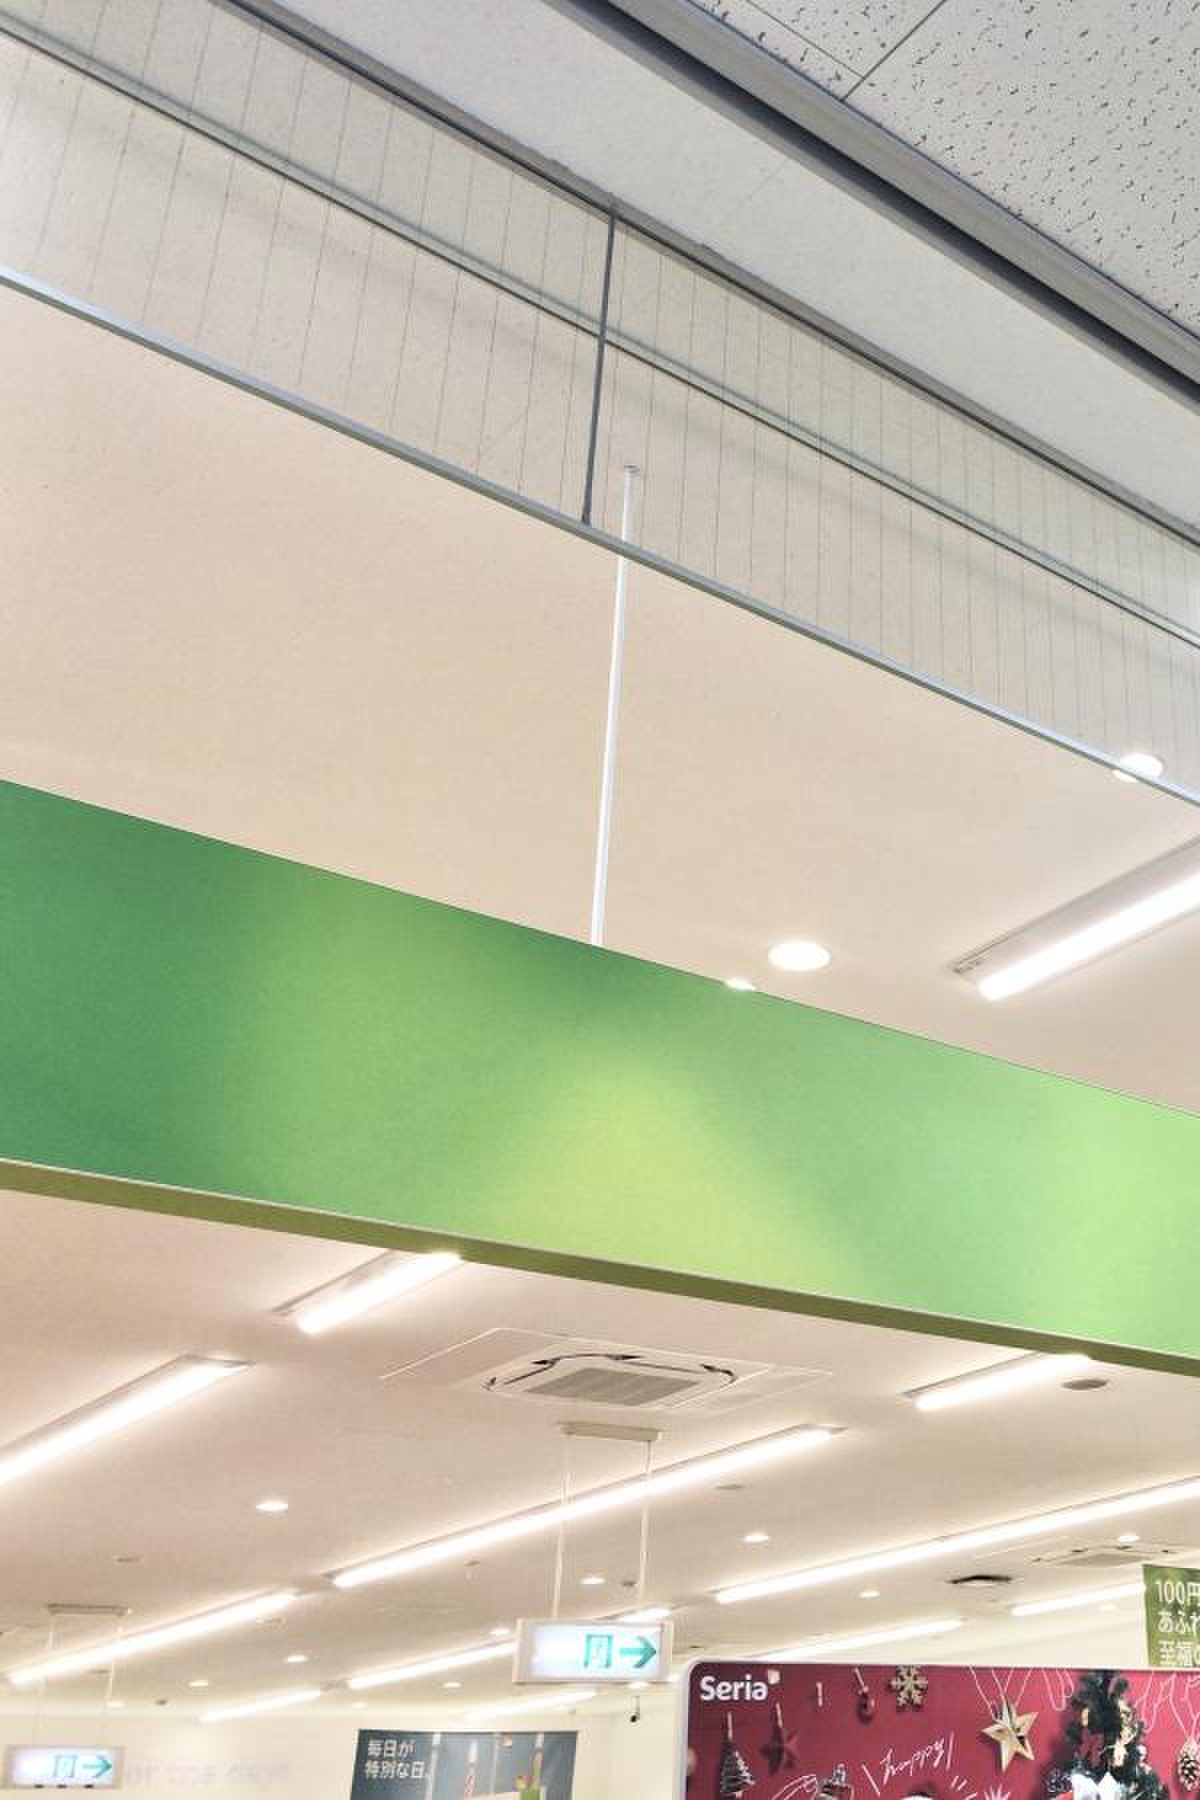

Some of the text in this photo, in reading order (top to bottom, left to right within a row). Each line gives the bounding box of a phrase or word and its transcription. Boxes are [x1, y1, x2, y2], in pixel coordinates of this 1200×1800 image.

[700, 1674, 768, 1701] Seria
[367, 1739, 416, 1758] 毎日が
